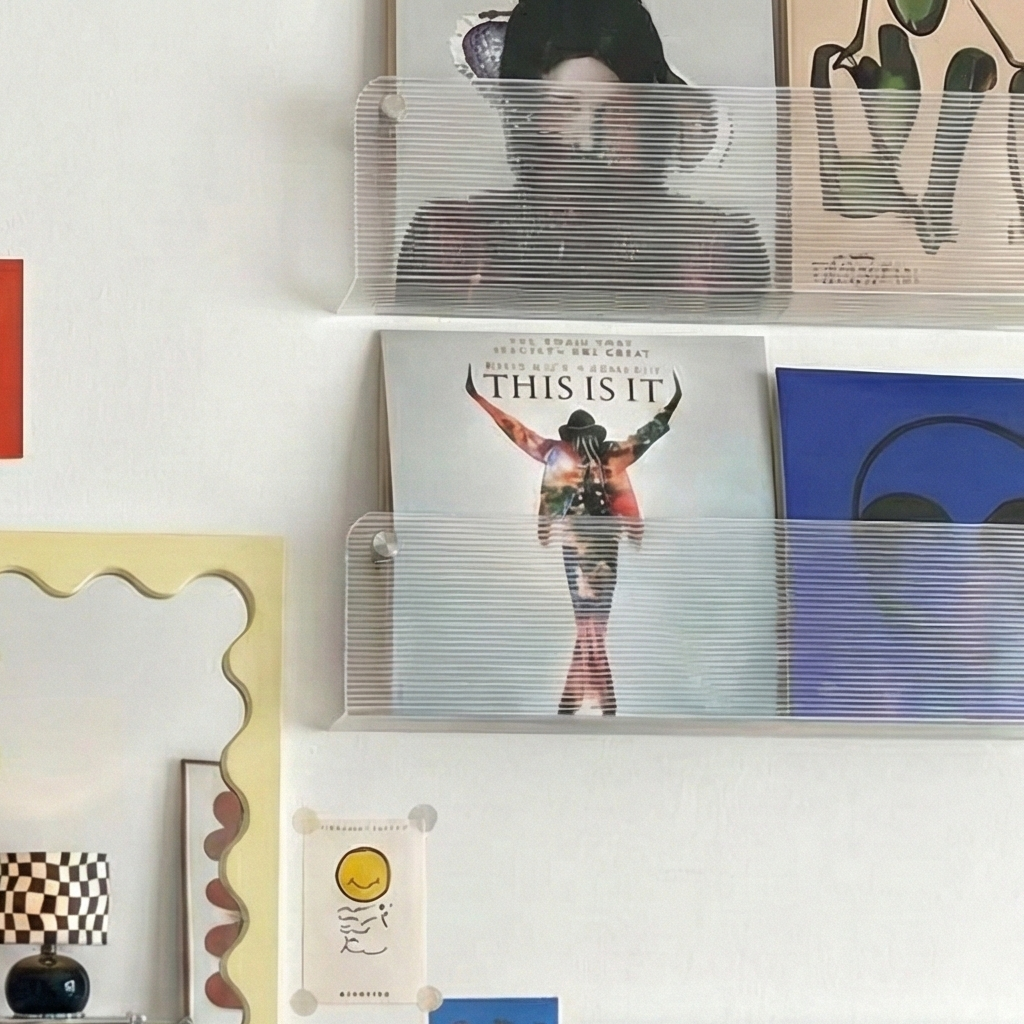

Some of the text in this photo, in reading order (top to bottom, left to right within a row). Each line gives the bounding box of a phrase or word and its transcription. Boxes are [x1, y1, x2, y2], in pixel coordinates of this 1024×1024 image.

[483, 373, 664, 403] THIS IS IT
